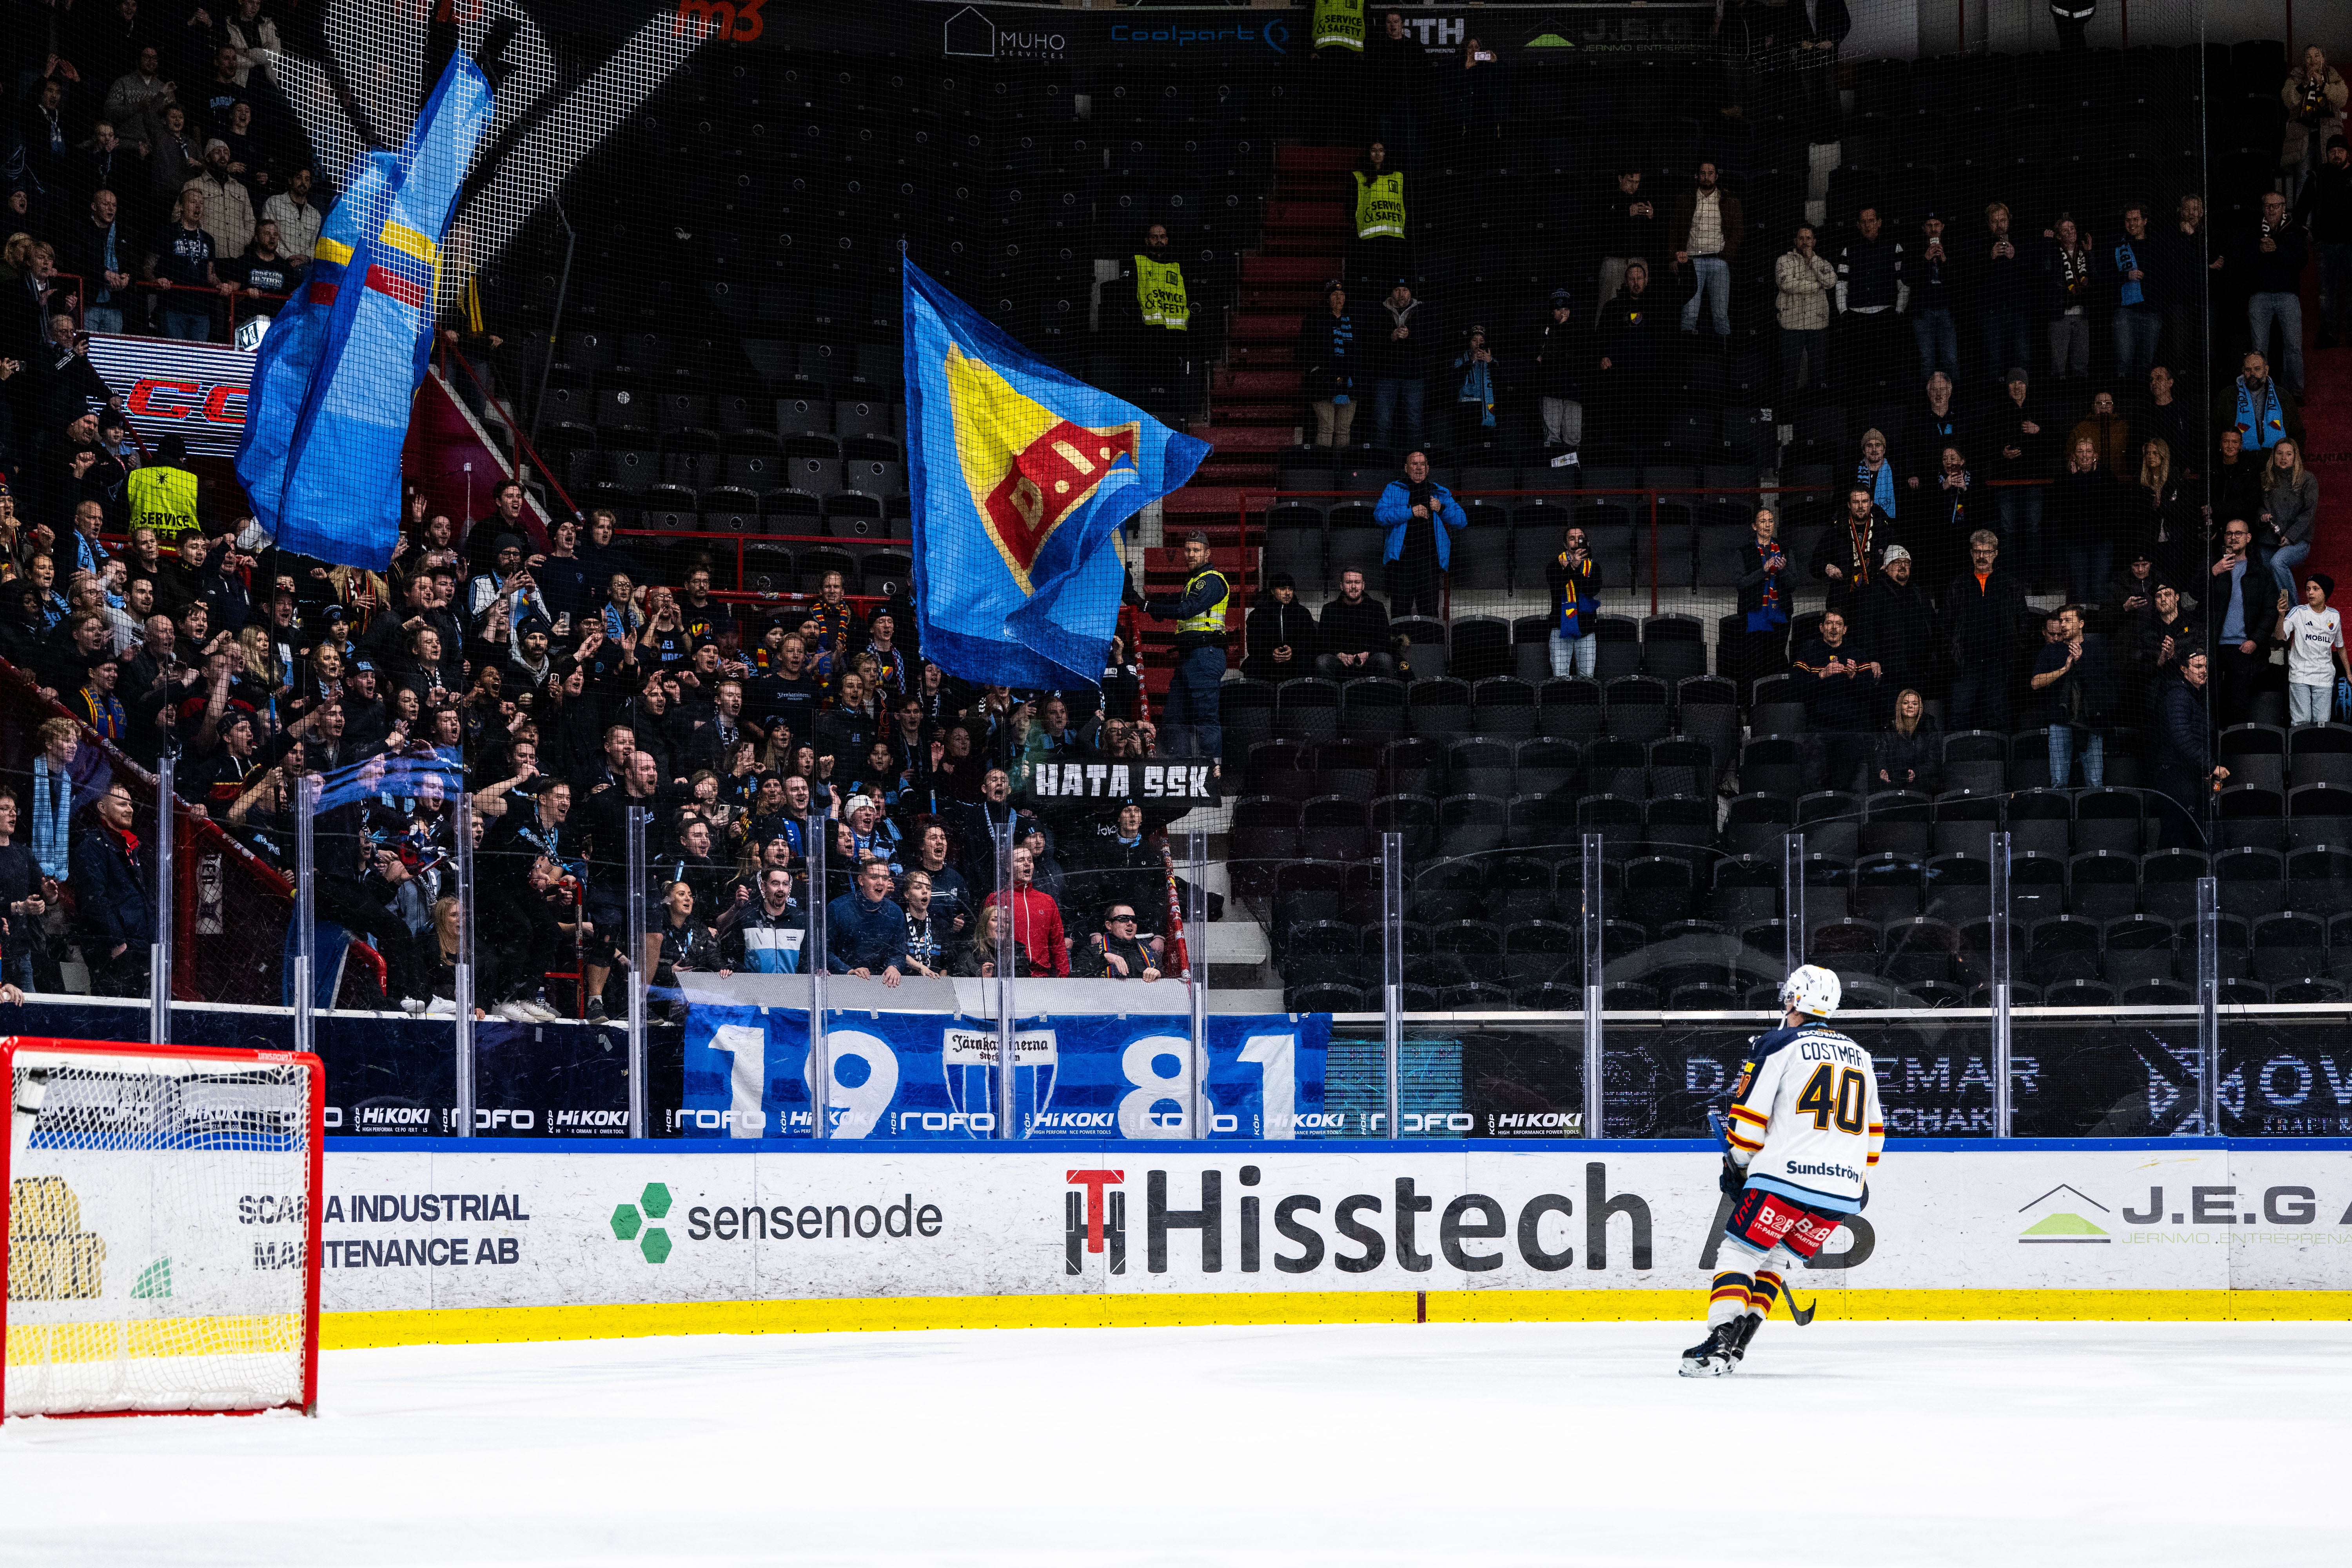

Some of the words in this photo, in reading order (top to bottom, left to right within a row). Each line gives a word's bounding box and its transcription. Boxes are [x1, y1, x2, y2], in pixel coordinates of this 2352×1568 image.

[1325, 15, 1362, 27] SERVICE
[1111, 24, 1254, 46] Coolpart
[1327, 24, 1361, 37] SAFETY
[1001, 31, 1065, 50] MUHO
[1001, 50, 1063, 60] SERVICES
[140, 512, 190, 527] SERVICE
[2305, 634, 2331, 643] MOBILL
[1036, 763, 1129, 797] HATA
[1143, 765, 1210, 797] SSK
[1796, 1062, 1866, 1135] 40
[363, 1107, 430, 1124] HiKOKI
[556, 1110, 630, 1126] HiKOKI
[1034, 1112, 1114, 1127] HiKOKI
[1499, 1113, 1583, 1127] HiKOKI
[351, 1193, 530, 1223] INDUSTRIAL
[2122, 1185, 2317, 1224] J.E.G
[687, 1193, 943, 1240] sensenode
[1147, 1162, 1653, 1275] Hisstech
[1795, 1218, 1831, 1241] B2B
[2122, 1232, 2211, 1244] JERNMO
[474, 1238, 520, 1265] AB
